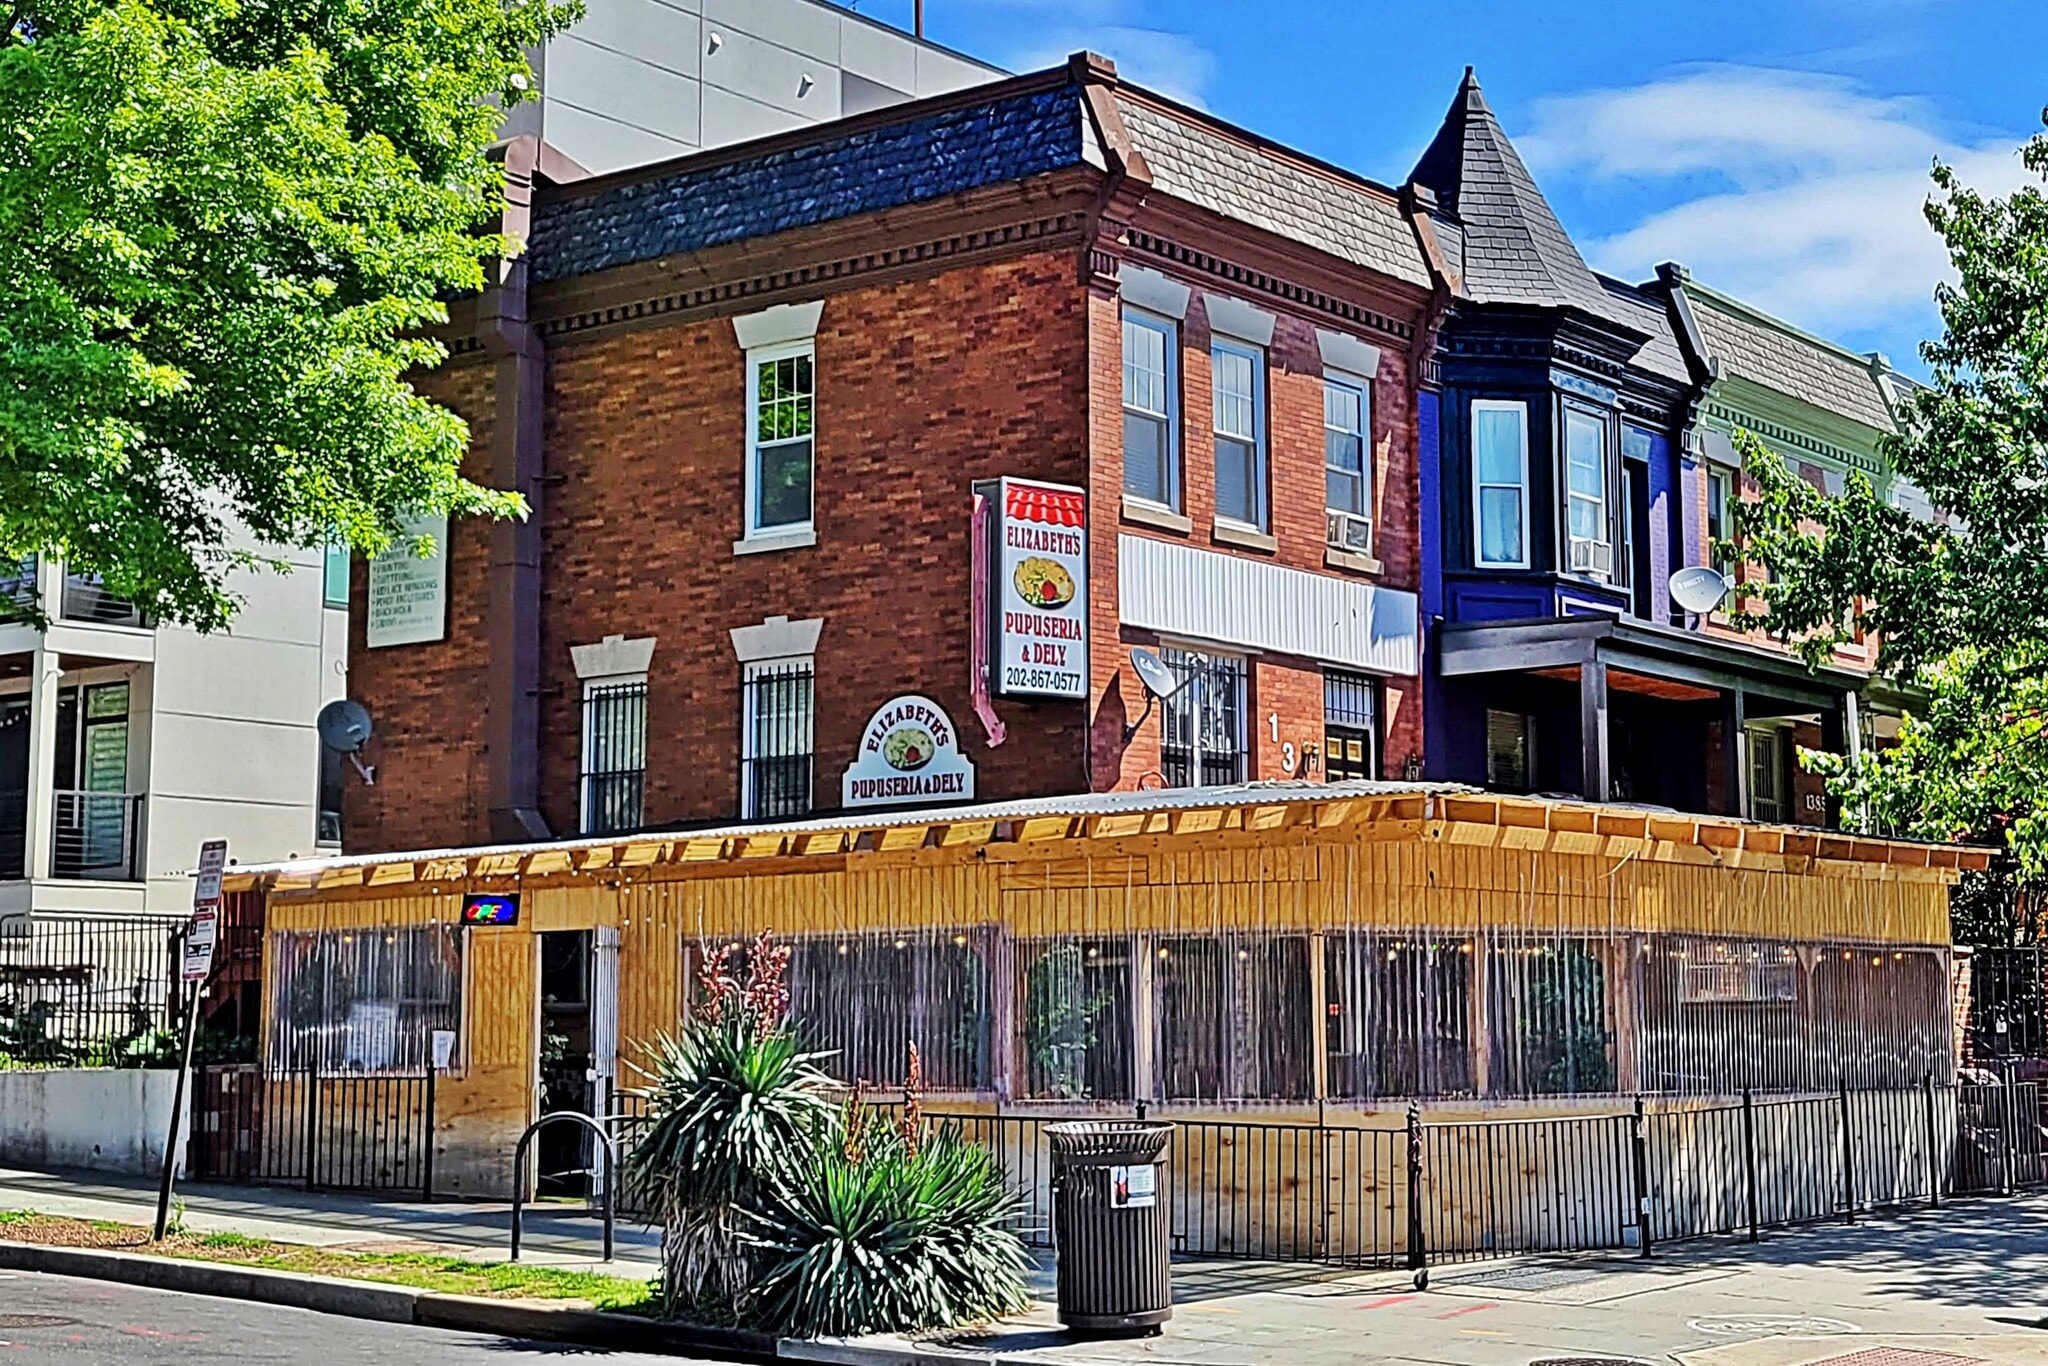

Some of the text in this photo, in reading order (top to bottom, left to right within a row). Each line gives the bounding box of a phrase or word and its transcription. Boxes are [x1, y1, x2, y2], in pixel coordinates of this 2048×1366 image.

[1007, 526, 1080, 556] ELIZABETH'S
[1005, 612, 1082, 641] PUPUSERIA
[1022, 642, 1066, 666] & DELY
[867, 704, 949, 753] ELIZABETH'S
[851, 776, 922, 799] PUPUSERIA
[932, 773, 965, 794] DELY
[467, 903, 508, 920] OPE
